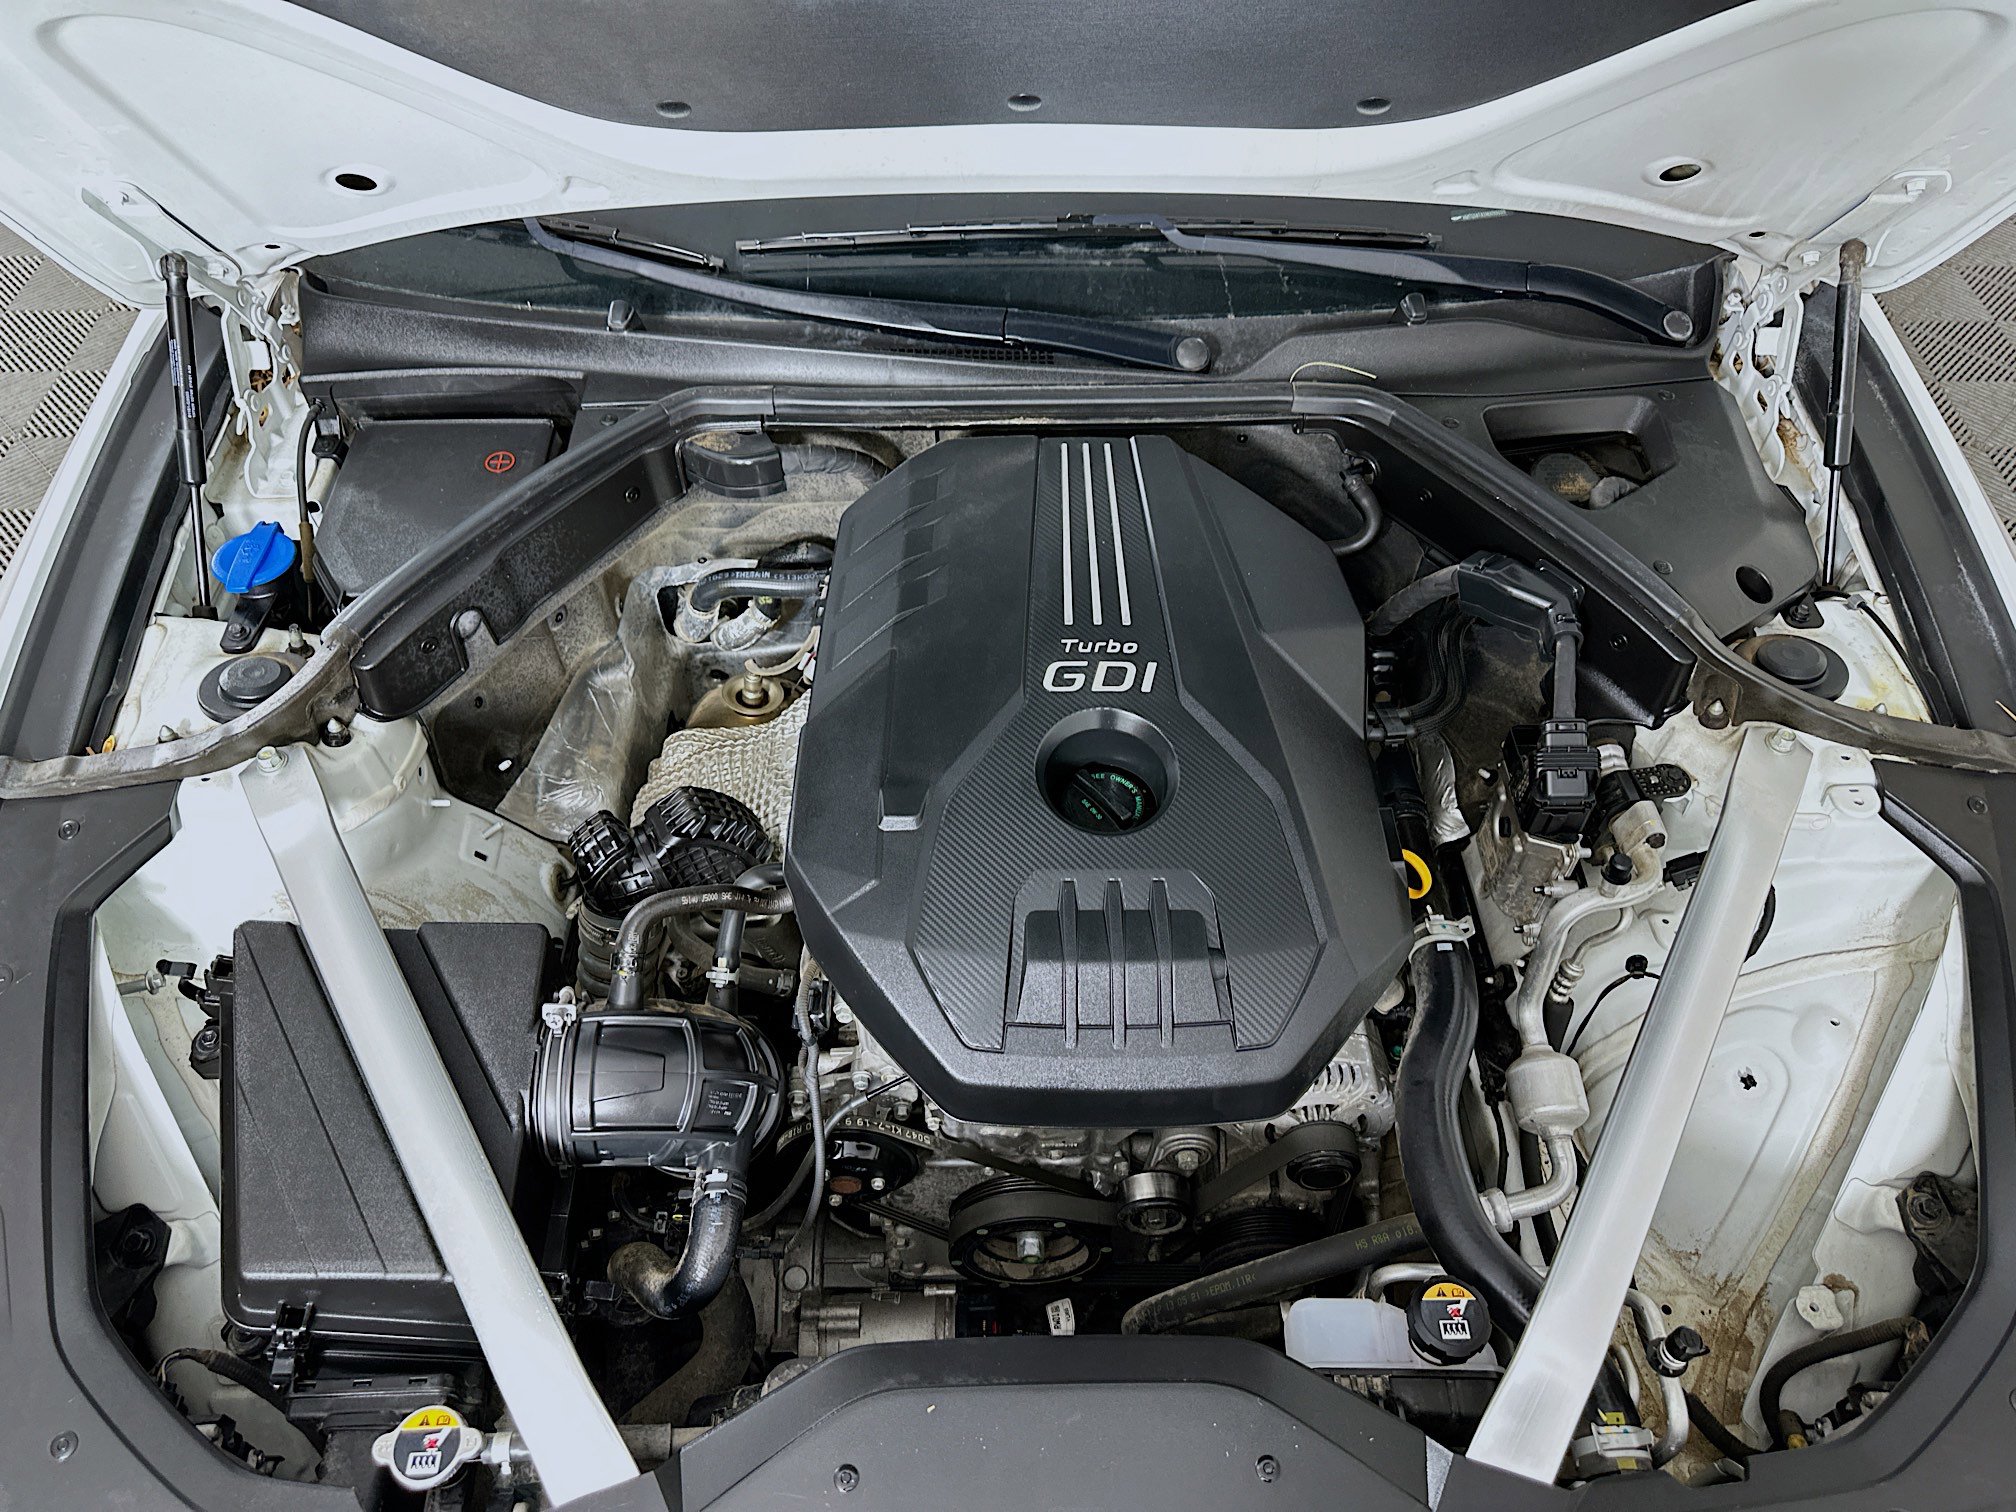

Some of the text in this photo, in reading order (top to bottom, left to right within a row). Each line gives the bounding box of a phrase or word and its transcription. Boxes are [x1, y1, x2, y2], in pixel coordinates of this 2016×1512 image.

[1061, 639, 1138, 654] Turbo
[1042, 661, 1158, 693] GDI
[1110, 774, 1139, 794] OWNER'S
